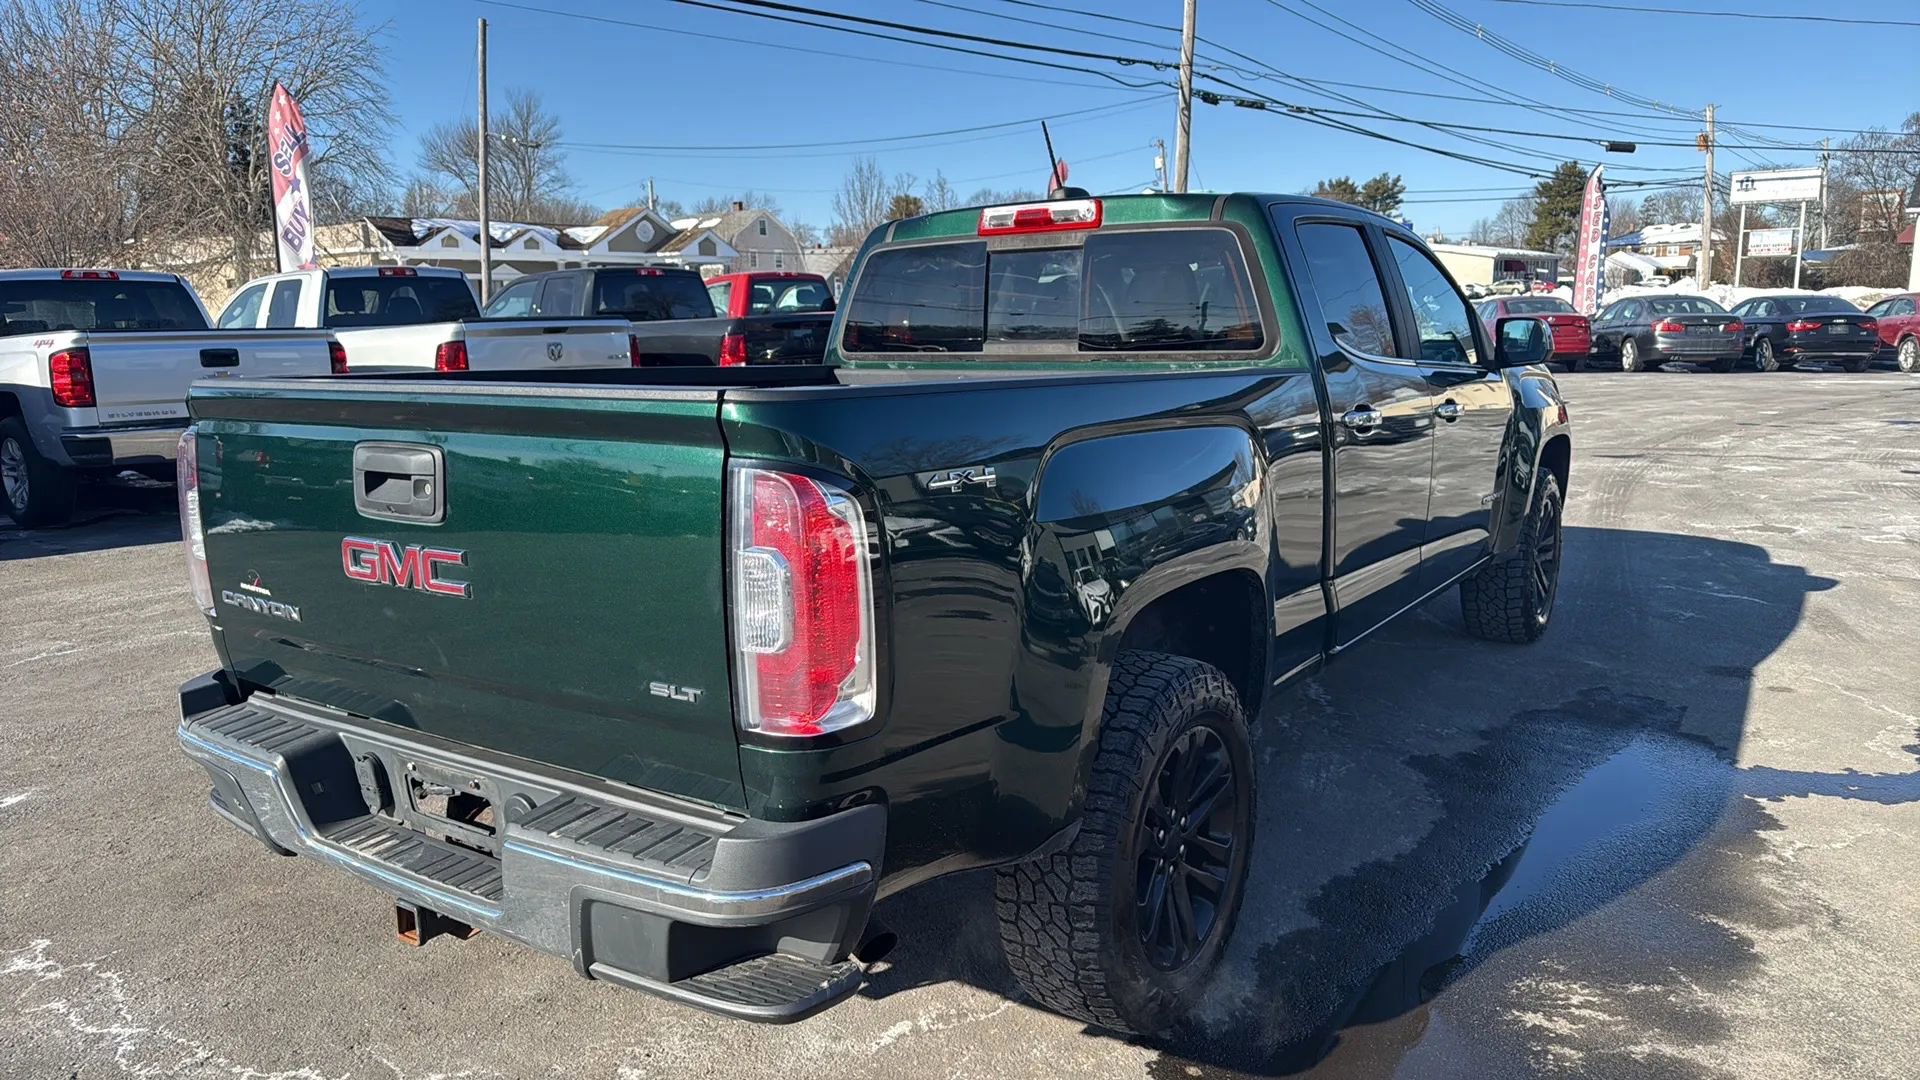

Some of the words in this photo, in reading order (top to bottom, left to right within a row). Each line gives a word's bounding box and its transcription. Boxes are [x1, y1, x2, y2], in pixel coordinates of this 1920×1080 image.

[273, 123, 306, 176] SELL
[281, 200, 310, 255] BUY
[1585, 254, 1597, 314] CARS
[342, 536, 473, 600] GMC
[222, 590, 302, 622] CANYON
[650, 682, 703, 702] SLT
